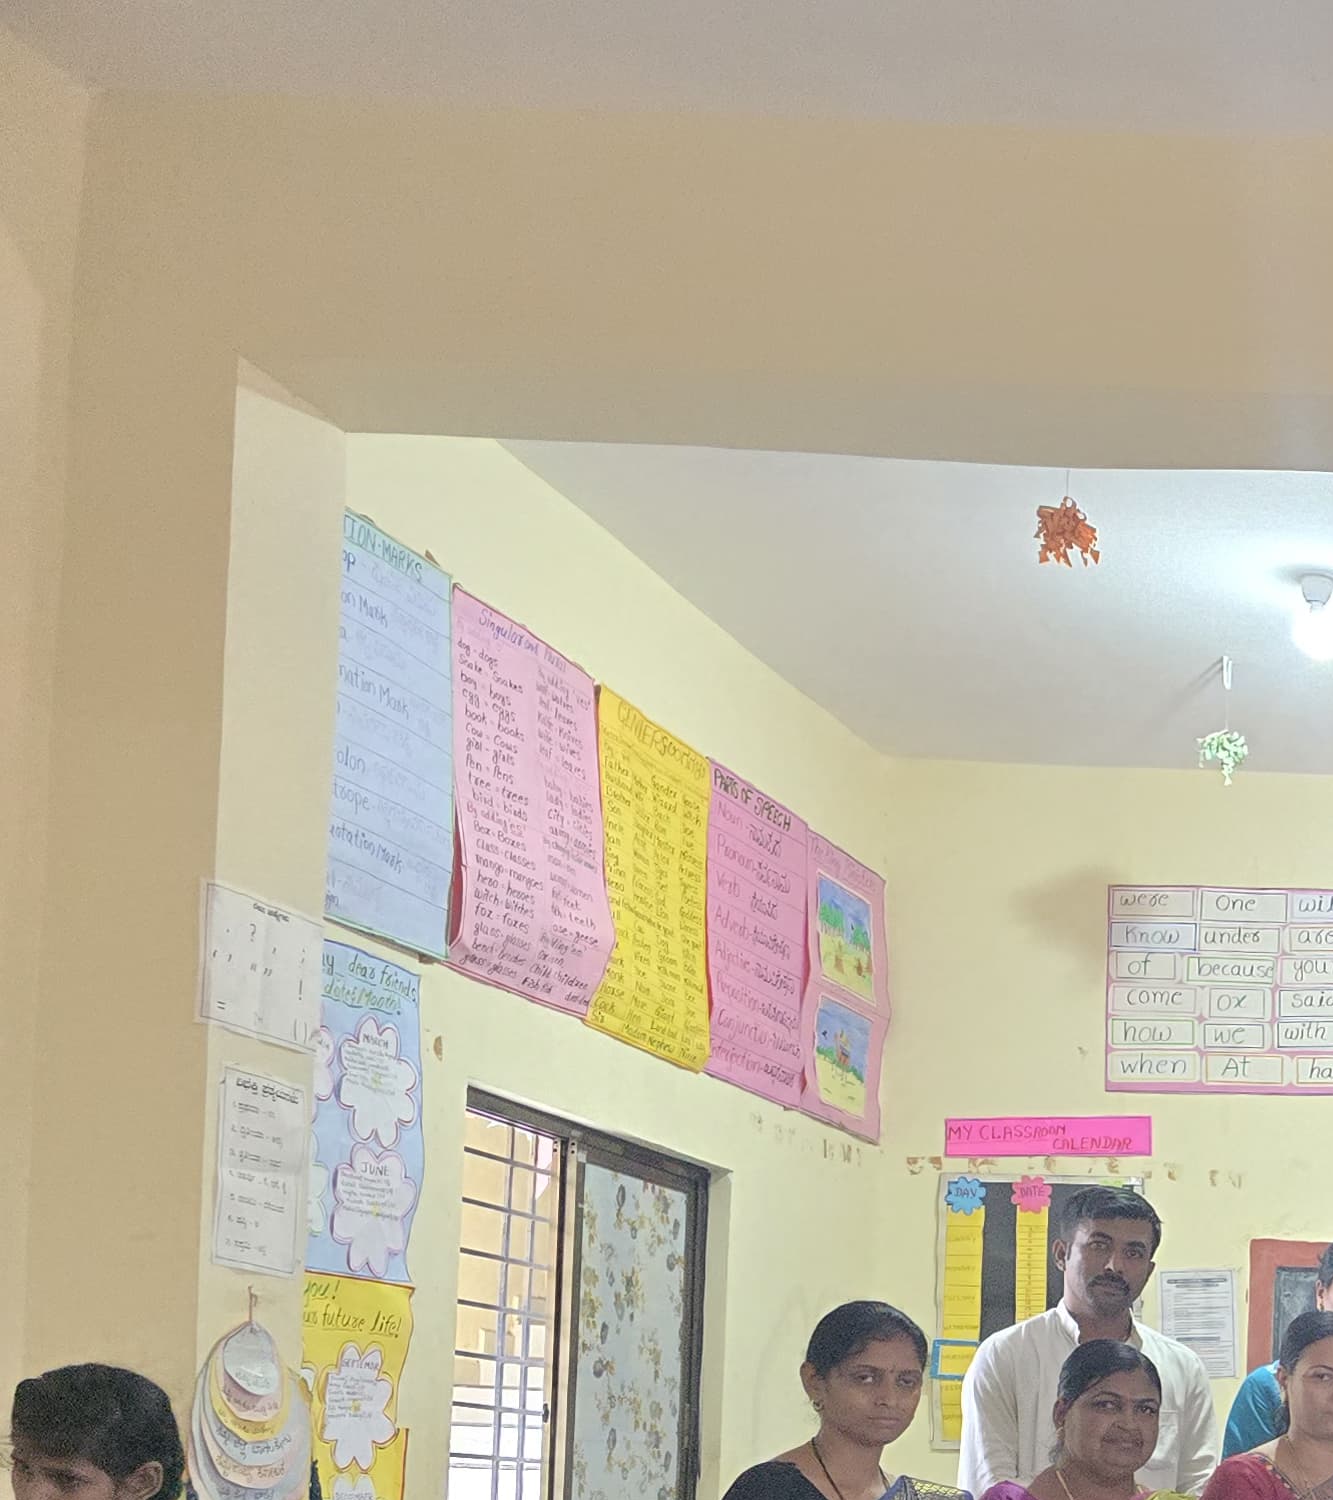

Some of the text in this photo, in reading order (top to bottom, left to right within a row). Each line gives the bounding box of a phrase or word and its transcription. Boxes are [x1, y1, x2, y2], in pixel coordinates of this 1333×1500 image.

[741, 787, 754, 804] OF
[753, 796, 792, 832] SPEECH
[1119, 892, 1170, 906] were
[1215, 894, 1257, 911] One
[1204, 927, 1261, 943] under
[1127, 952, 1152, 976] of
[1197, 958, 1274, 978] because
[1126, 988, 1183, 1006] come
[1122, 1022, 1173, 1042] how
[1214, 1026, 1246, 1045] we
[1284, 1023, 1328, 1041] with
[1120, 1053, 1187, 1075] when
[1221, 1057, 1251, 1077] At
[949, 1125, 973, 1140] MY
[1052, 1137, 1132, 1150] CALENDAR
[360, 1162, 390, 1177] JUNE
[322, 1303, 366, 1330] future
